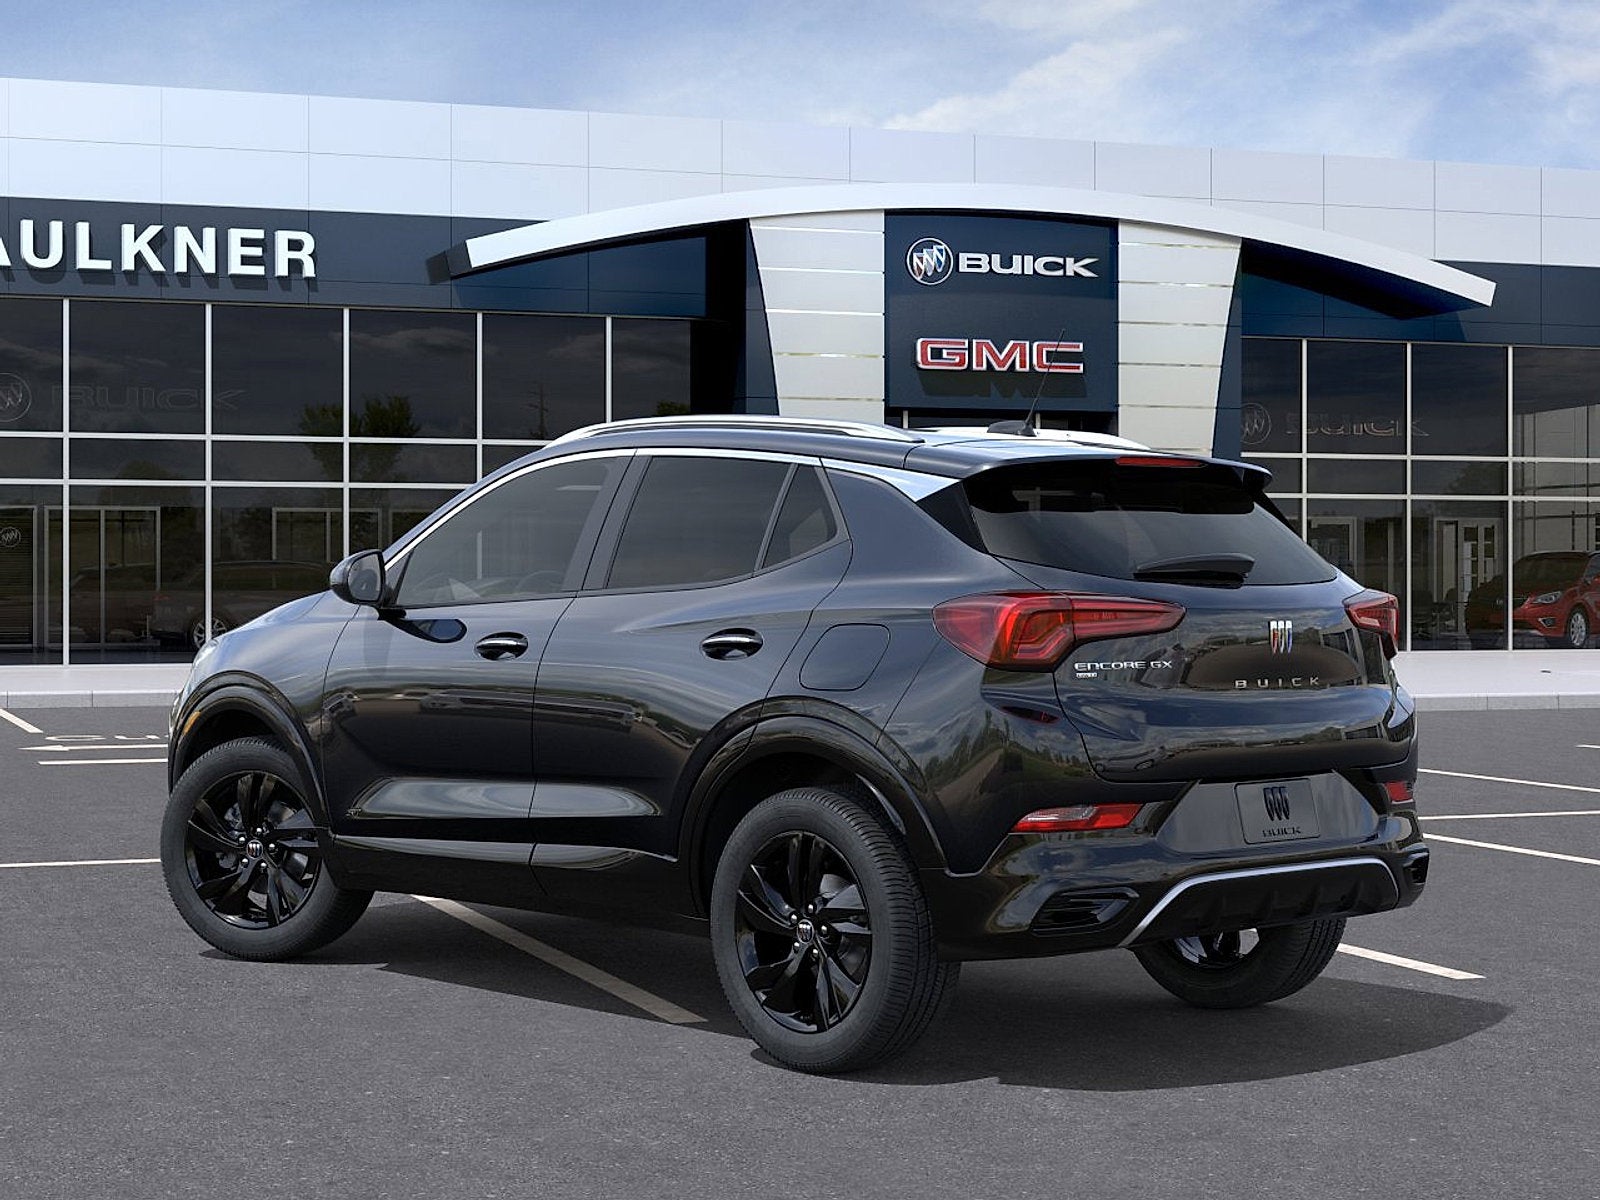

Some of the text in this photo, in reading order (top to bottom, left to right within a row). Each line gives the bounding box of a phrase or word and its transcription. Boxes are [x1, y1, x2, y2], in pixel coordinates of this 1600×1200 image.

[0, 218, 316, 278] ULKNER
[958, 252, 1099, 278] BUICK
[917, 337, 1084, 374] GMC
[1074, 660, 1173, 672] ENCORE GX
[1234, 676, 1319, 689] BUICK
[1262, 826, 1301, 838] BUICK
